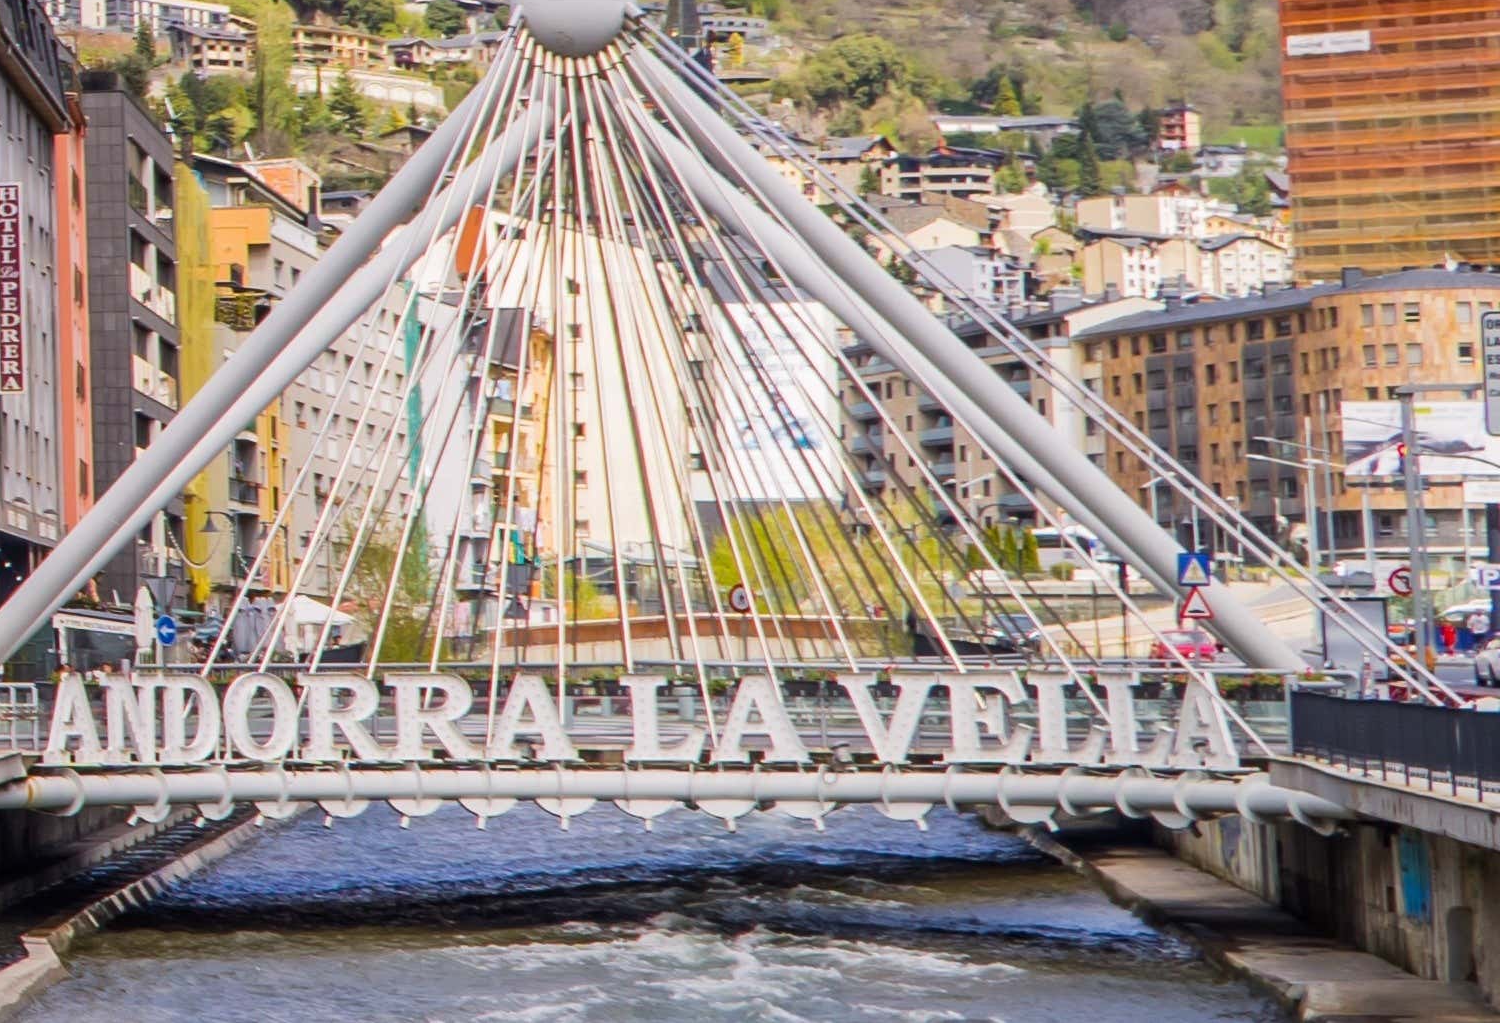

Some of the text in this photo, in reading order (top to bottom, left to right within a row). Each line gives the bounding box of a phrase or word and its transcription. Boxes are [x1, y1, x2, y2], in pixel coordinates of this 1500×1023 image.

[0, 281, 22, 390] PEDRERA
[43, 669, 1243, 773] ANDORRA LA VELLA
